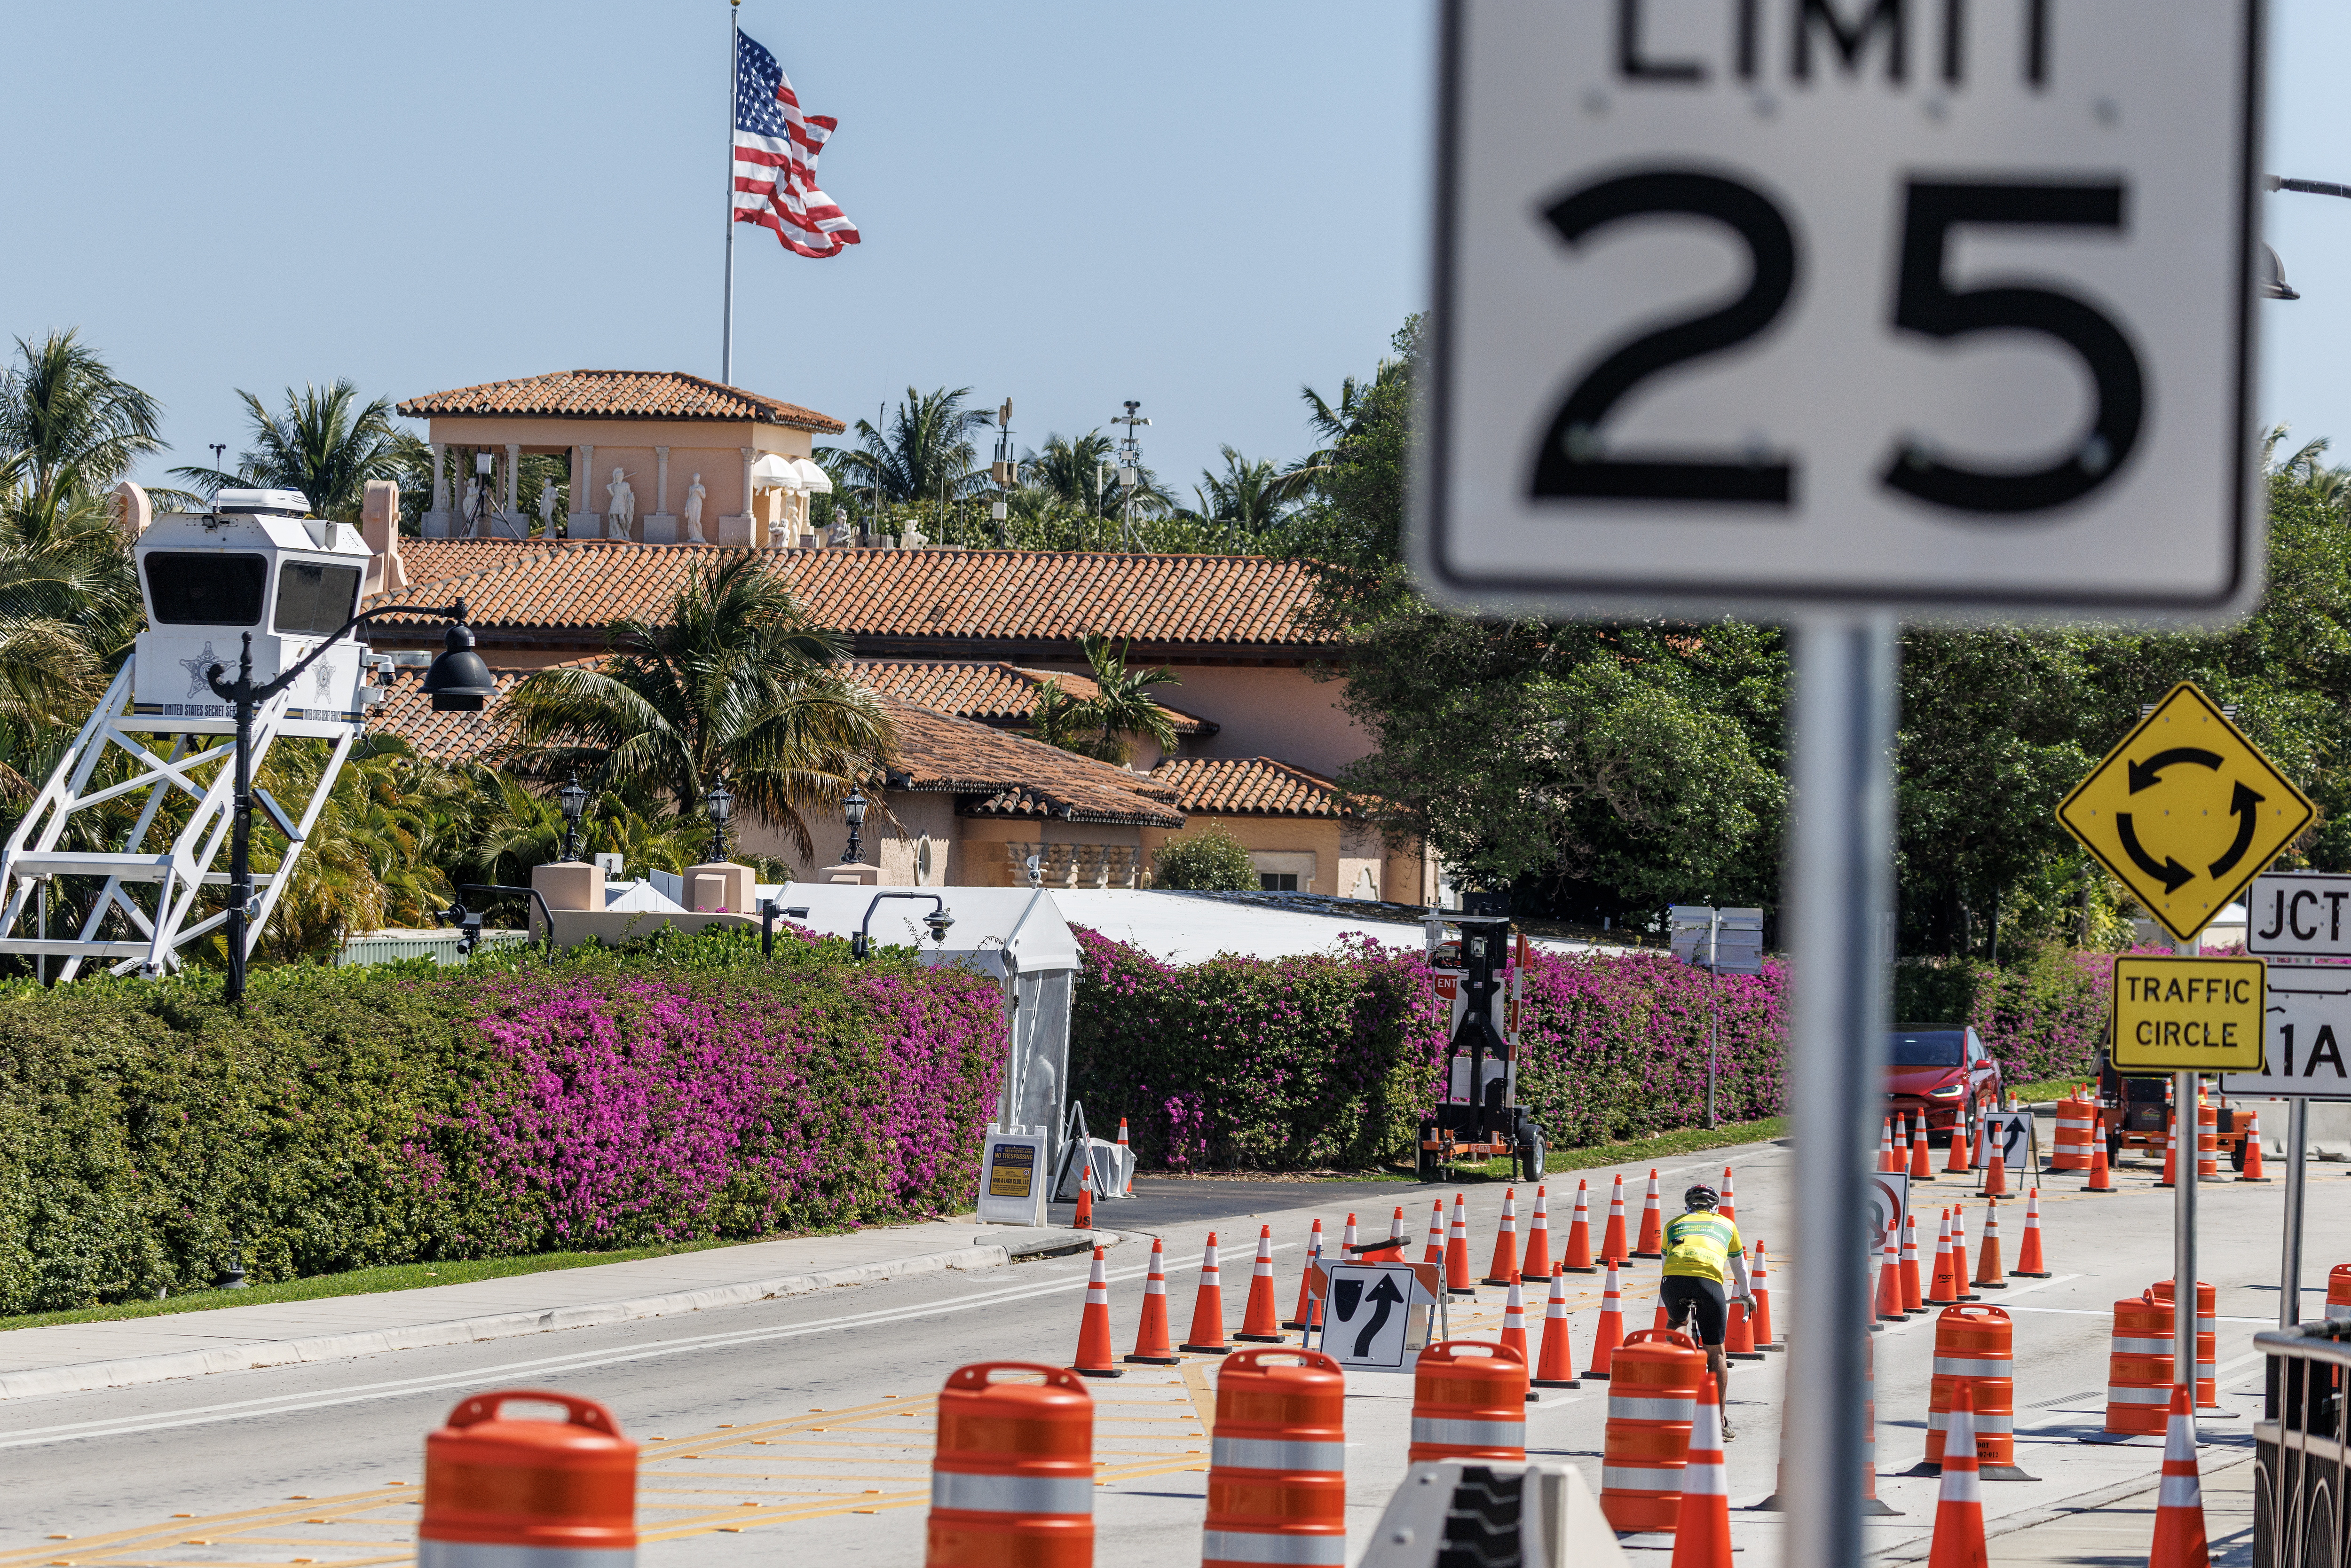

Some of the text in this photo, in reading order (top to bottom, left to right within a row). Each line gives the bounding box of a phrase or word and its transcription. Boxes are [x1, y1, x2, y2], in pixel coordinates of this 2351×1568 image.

[1527, 165, 2148, 517] 25
[165, 704, 183, 715] UNITED
[185, 704, 203, 716] STATES
[205, 705, 224, 717] SECRET
[322, 710, 330, 721] SECRET
[331, 710, 340, 722] SERVICE
[2258, 890, 2349, 941] JCT
[1438, 978, 1457, 988] ENT
[2126, 977, 2250, 1004] TRAFFIC
[2136, 1020, 2238, 1048] CIRCLE
[1074, 1215, 1090, 1226] US
